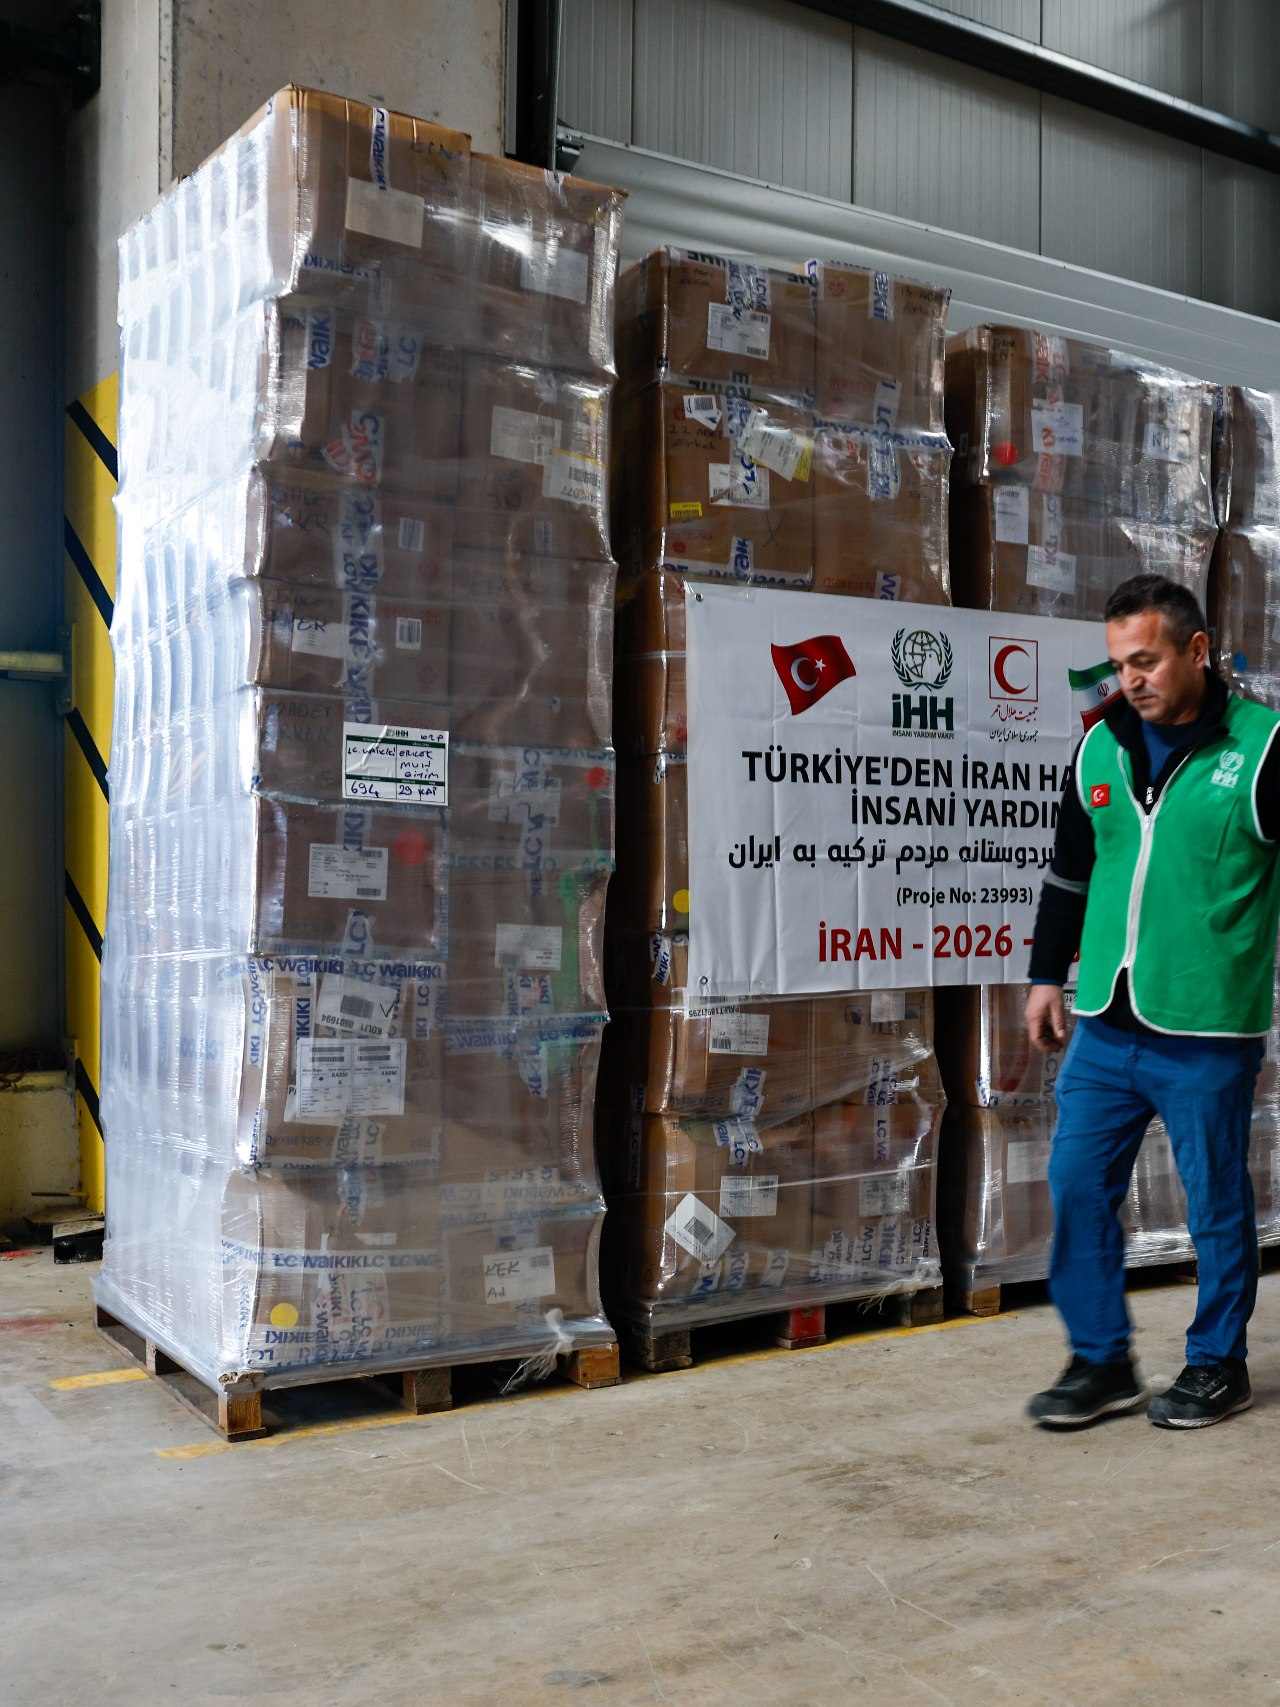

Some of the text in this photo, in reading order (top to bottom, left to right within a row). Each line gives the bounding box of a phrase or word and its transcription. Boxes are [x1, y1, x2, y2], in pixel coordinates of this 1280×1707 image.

[742, 745, 952, 788] TÜRKİYE'DEN
[963, 754, 1030, 791] İRAN
[399, 785, 412, 796] 29
[851, 788, 956, 827] İNSANİ
[729, 834, 781, 869] ایران
[792, 843, 816, 869] به
[827, 836, 886, 869] ترکیه
[895, 844, 950, 875] مردم
[896, 887, 1034, 908] (Proje No: 23993)
[819, 921, 903, 962] İRAN
[932, 923, 1013, 959] 2026
[417, 983, 430, 1006] LC
